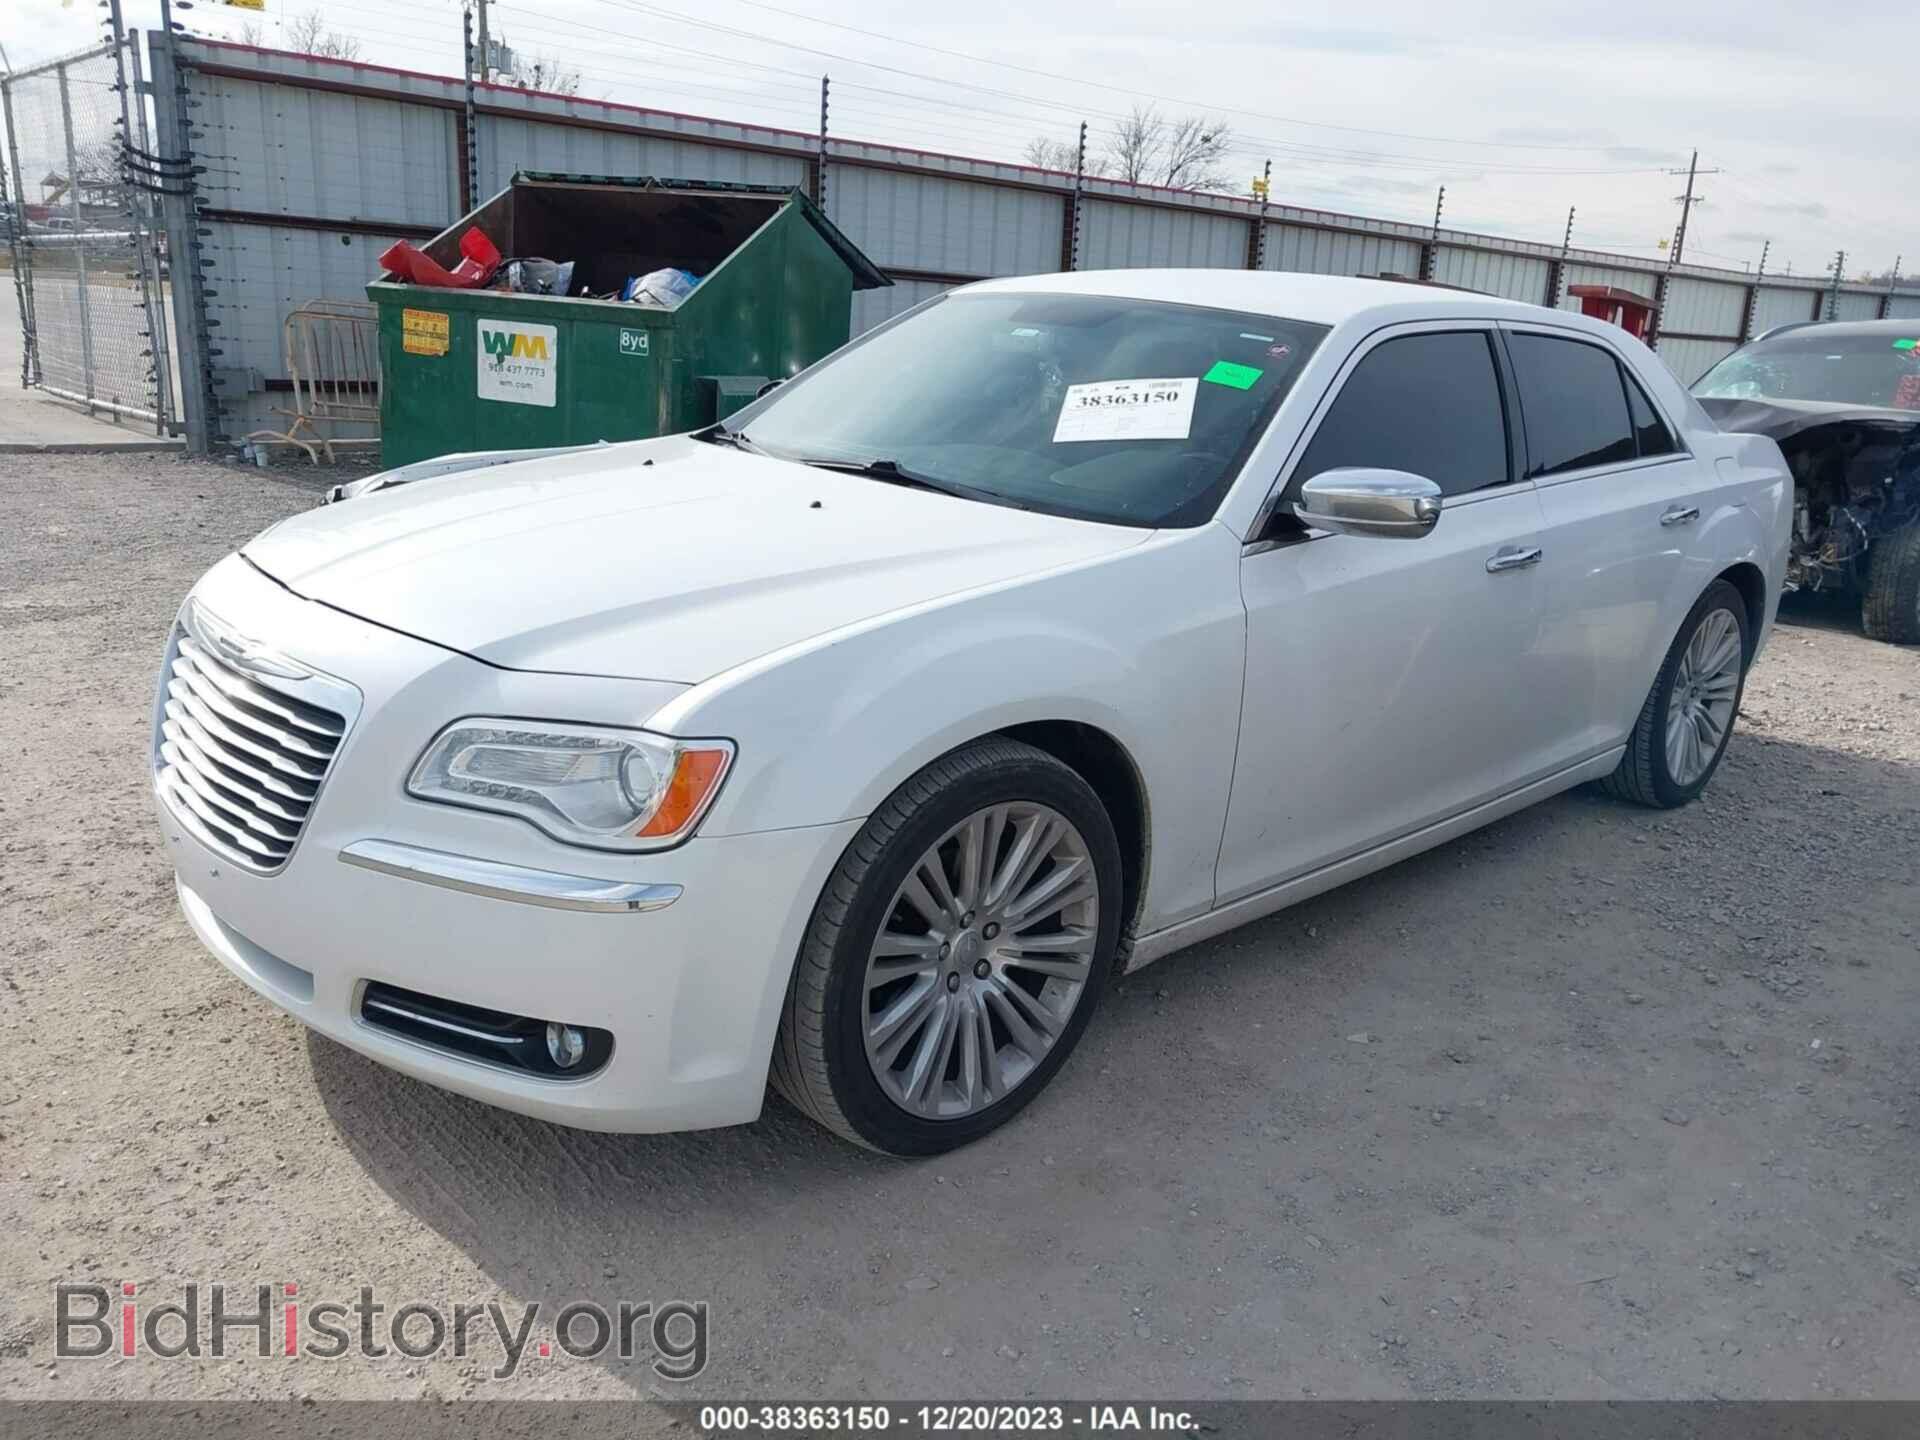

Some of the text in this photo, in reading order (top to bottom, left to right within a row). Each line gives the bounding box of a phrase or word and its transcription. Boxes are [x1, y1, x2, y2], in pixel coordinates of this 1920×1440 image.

[482, 330, 550, 360] WM
[622, 331, 648, 351] 8yd
[1075, 391, 1179, 408] 38363150
